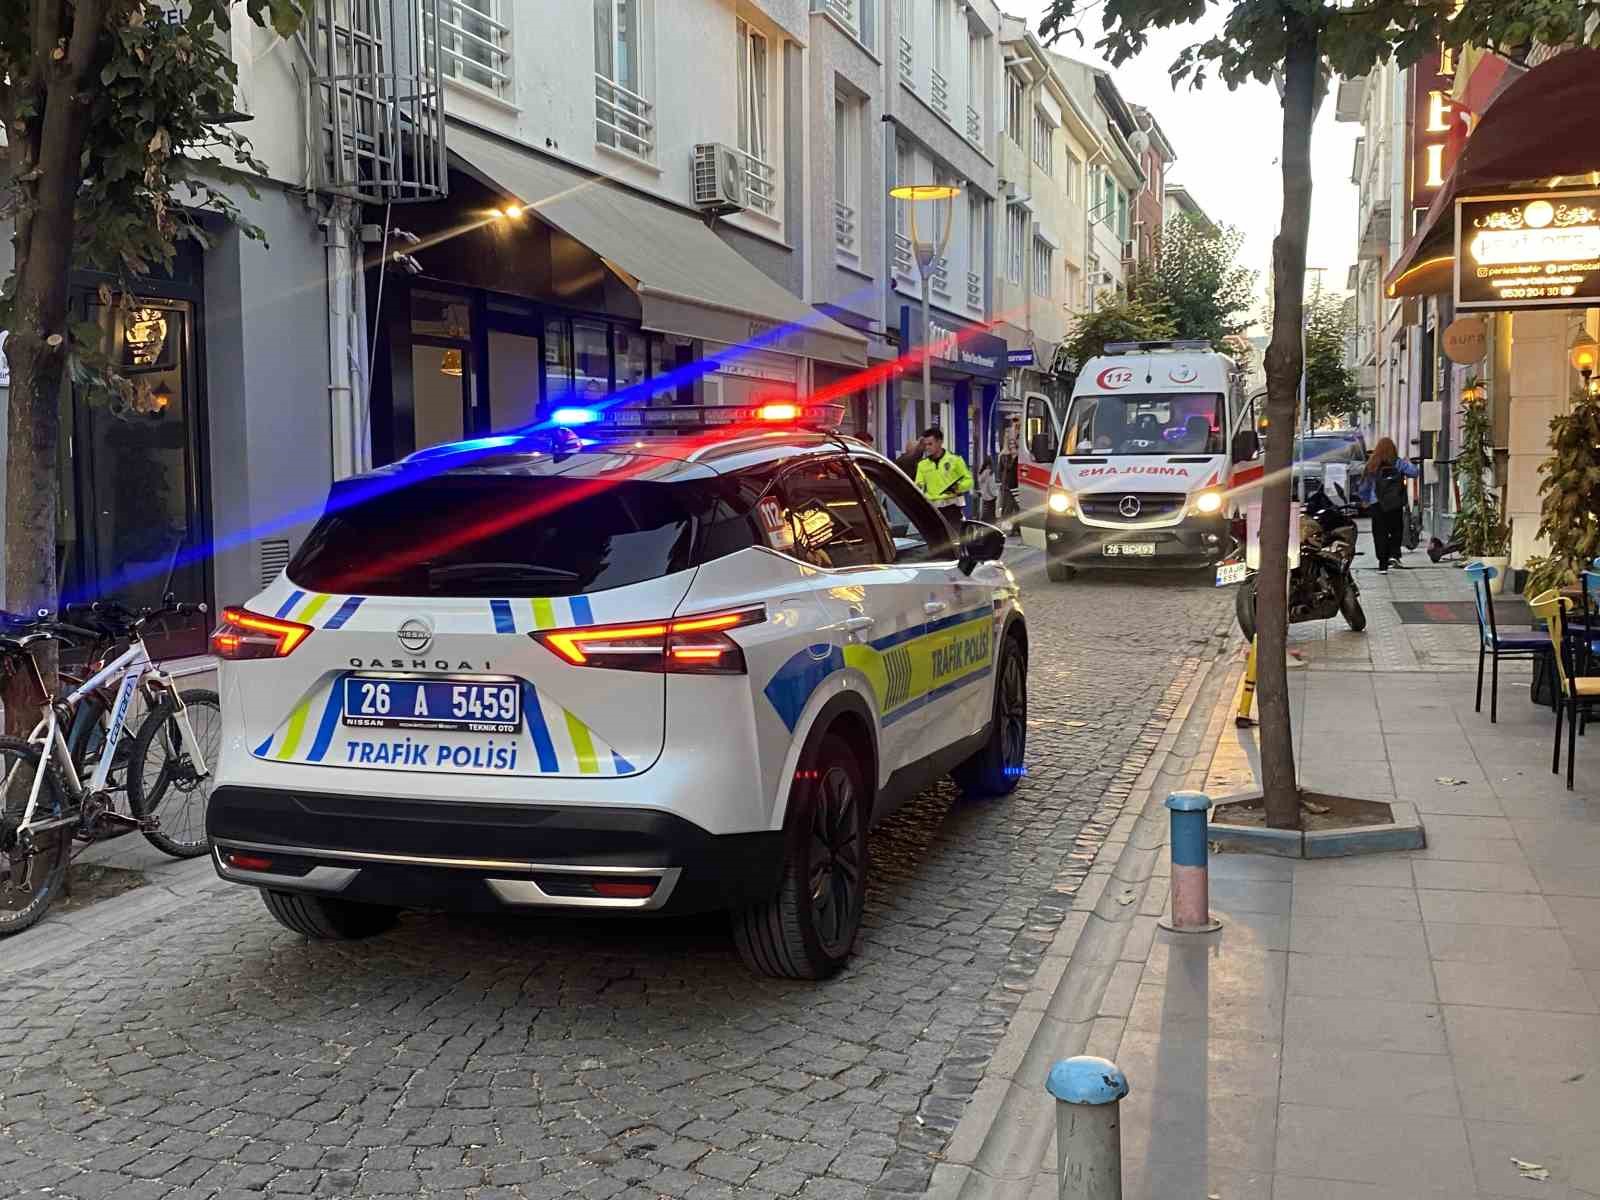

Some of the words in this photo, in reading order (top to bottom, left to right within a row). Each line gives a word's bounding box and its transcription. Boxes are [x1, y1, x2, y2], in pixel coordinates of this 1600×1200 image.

[1106, 372, 1133, 383] 112
[399, 631, 432, 639] NISSAN
[349, 657, 491, 670] QASHQAI
[930, 635, 962, 680] TRAFİK
[360, 682, 391, 715] 26
[414, 685, 429, 716] A
[451, 685, 515, 720] 5459
[346, 719, 384, 727] NISSAN
[498, 725, 514, 733] OTO
[346, 737, 430, 766] TRAFİK
[435, 740, 519, 770] POLİSİ
